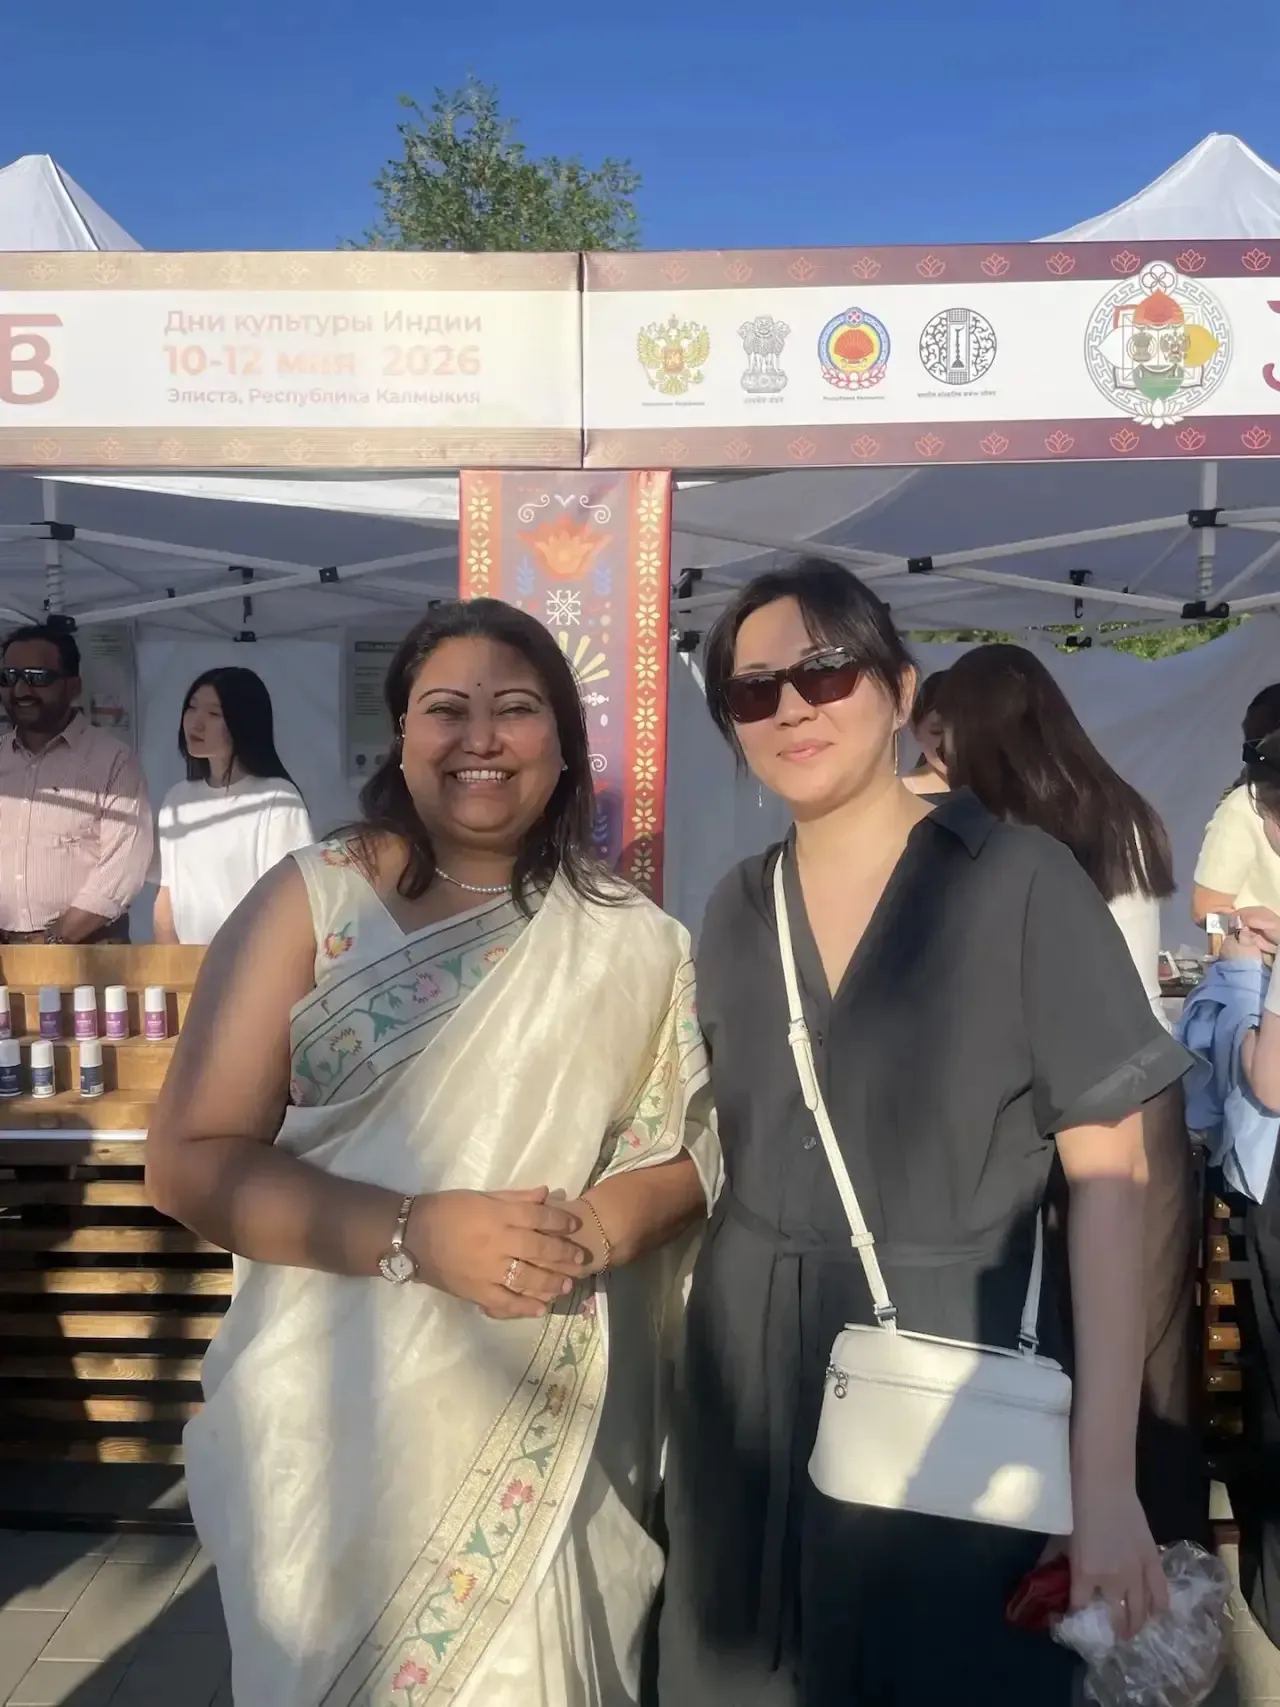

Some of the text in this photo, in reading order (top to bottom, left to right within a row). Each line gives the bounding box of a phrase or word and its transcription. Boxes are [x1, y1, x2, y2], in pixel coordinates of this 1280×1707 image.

[163, 310, 482, 337] Дни культуры Индии
[163, 344, 263, 376] 10-12
[381, 344, 482, 376] 2026
[167, 388, 481, 407] Элиста, Республика Калмыкия
